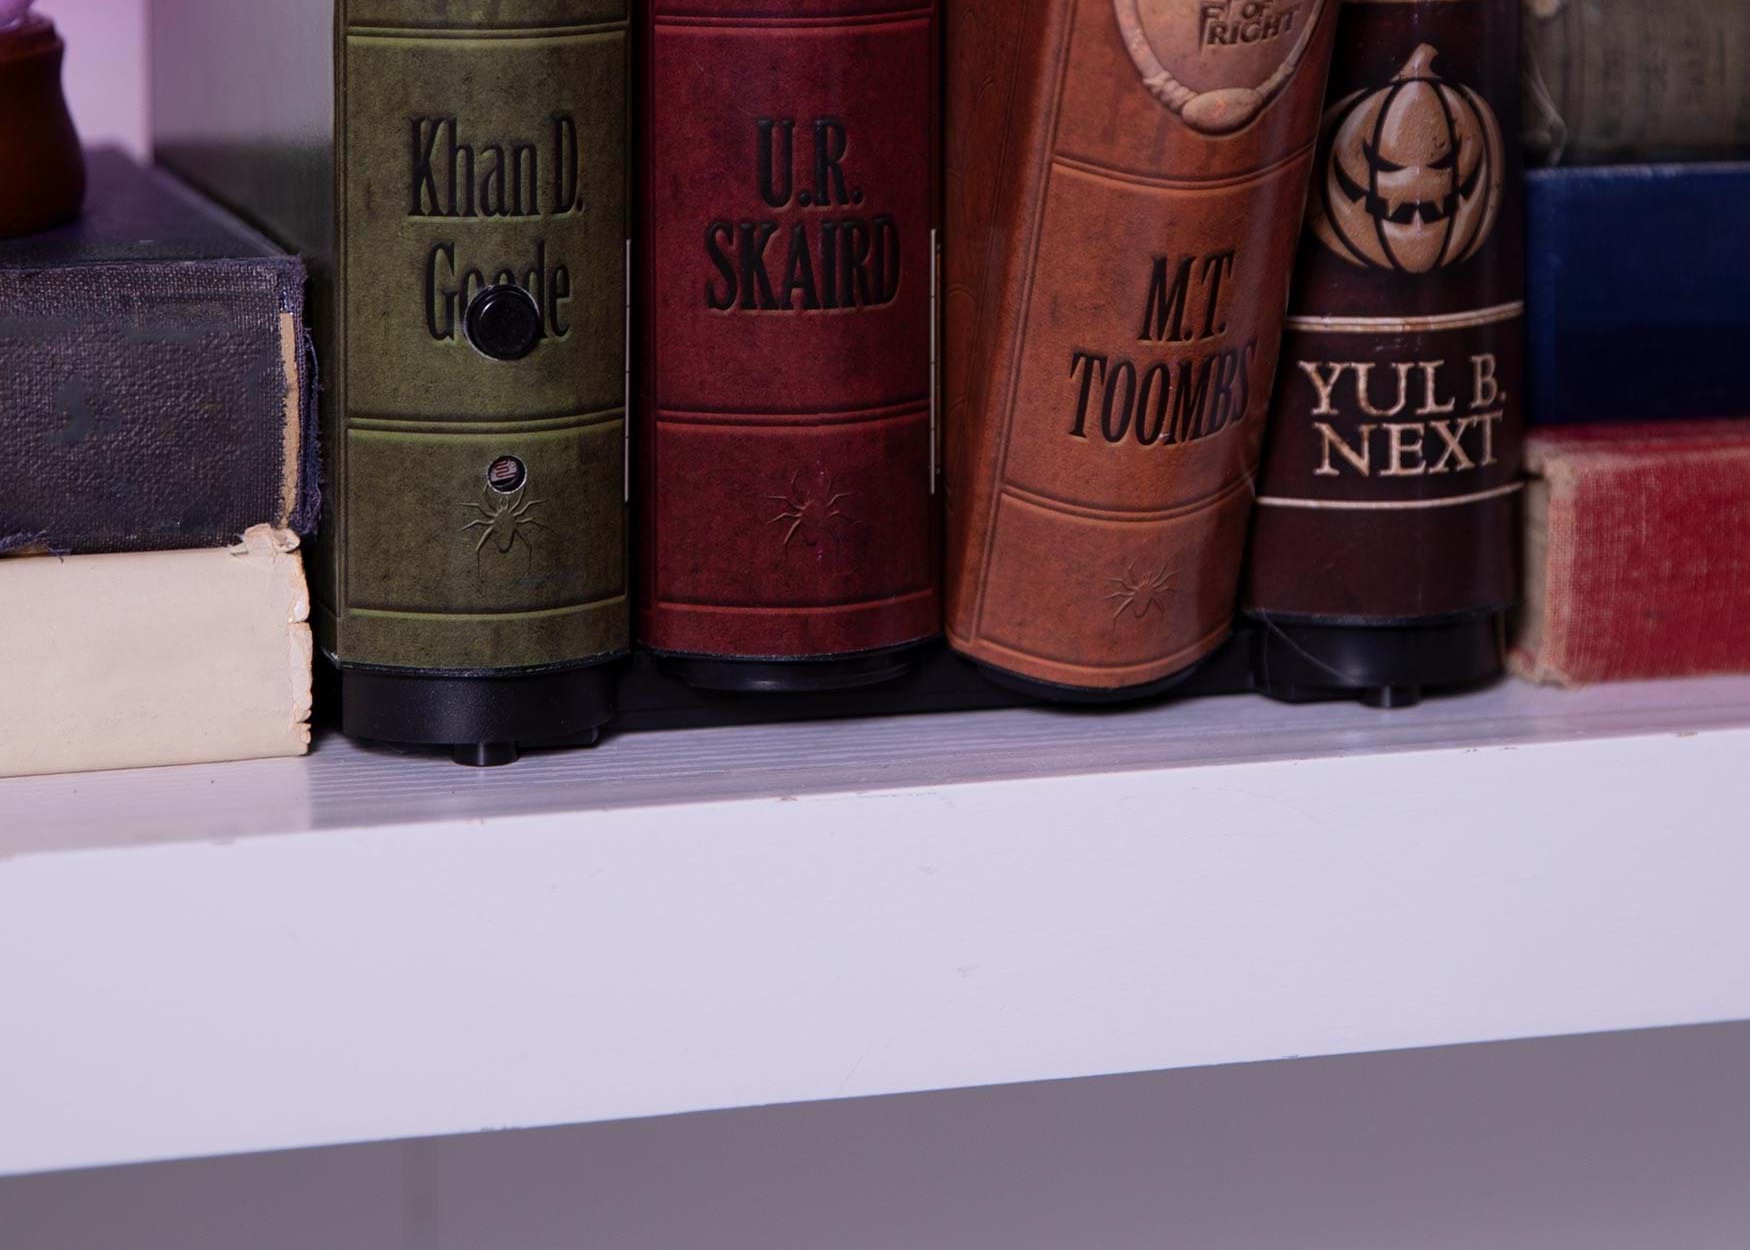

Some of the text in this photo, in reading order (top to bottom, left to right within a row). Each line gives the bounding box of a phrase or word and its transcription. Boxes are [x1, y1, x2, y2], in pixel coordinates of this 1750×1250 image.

[1198, 1, 1300, 52] FRIGHT
[1241, 0, 1277, 20] OF
[407, 113, 584, 218] Khan D.
[757, 115, 864, 209] U.R.
[706, 217, 899, 312] SKAIRD
[1068, 339, 1258, 447] TOOMBS
[1298, 353, 1507, 417] YUL B.
[1313, 409, 1504, 478] NEXT
